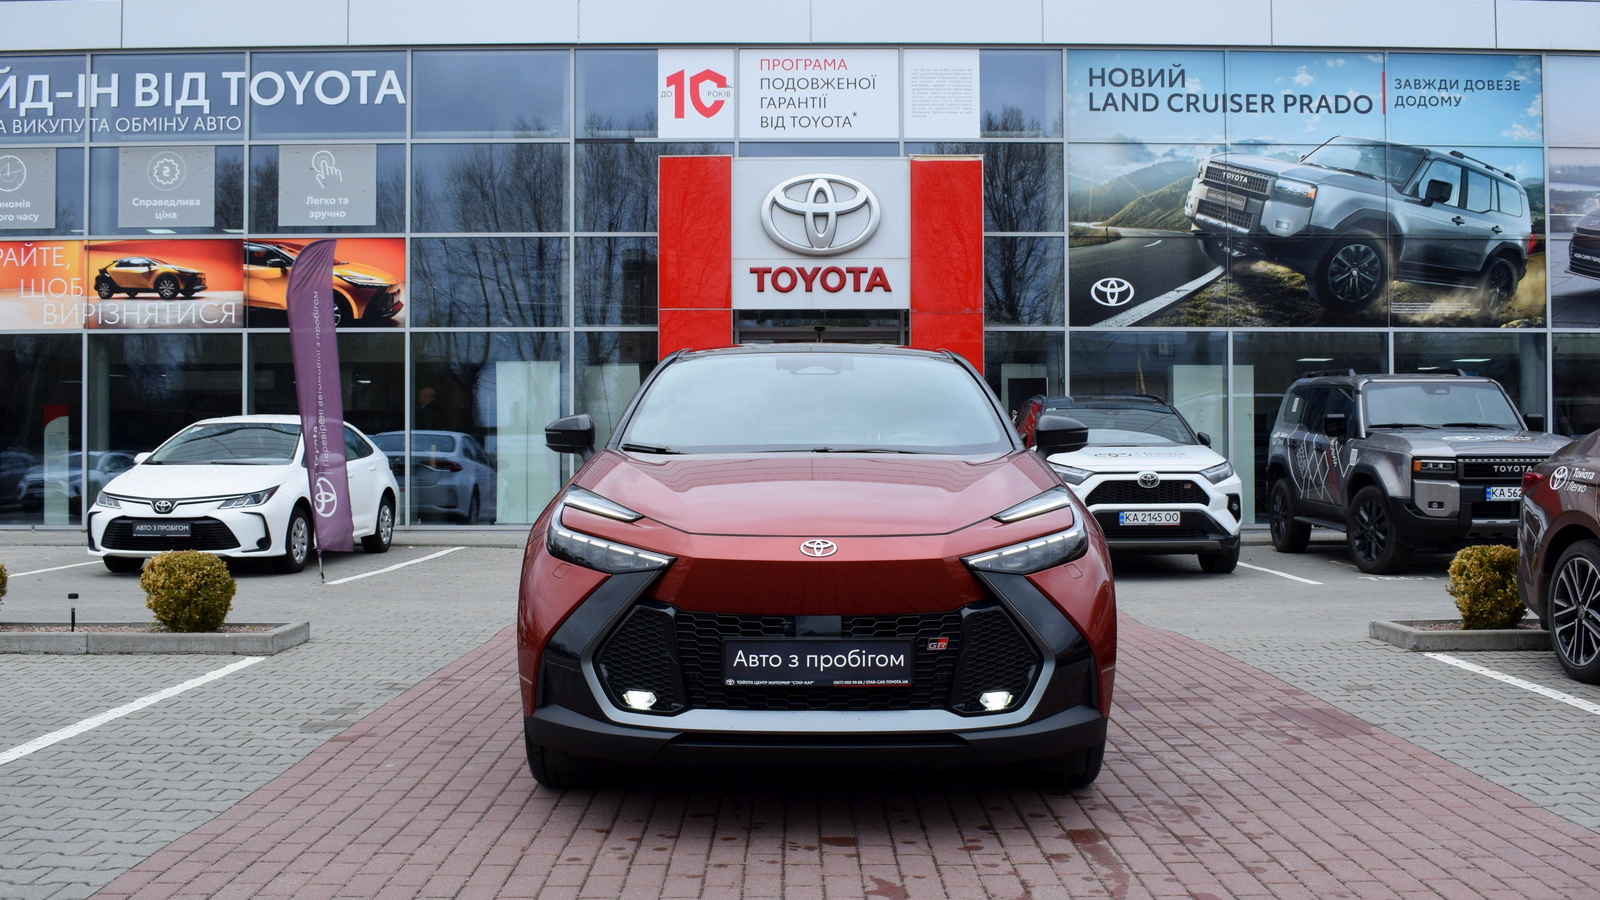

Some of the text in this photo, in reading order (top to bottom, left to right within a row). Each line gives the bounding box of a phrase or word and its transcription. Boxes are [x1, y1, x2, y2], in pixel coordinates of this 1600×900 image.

[759, 58, 848, 71] ПРОГРАМА
[1087, 64, 1186, 88] НОВИЙ
[759, 75, 877, 92] ПОДОВЖЕНОЇ
[1394, 78, 1521, 93] ЗАВЖДИ ДОВЕЗЕ
[135, 73, 209, 114] ВІД
[222, 70, 406, 106] TOYOTA
[660, 90, 673, 98] ДО
[707, 90, 731, 98] РОКІВ
[759, 95, 827, 109] ГАРАНТІЇ
[1088, 92, 1374, 115] LAND CRUISER PRADO
[1394, 95, 1463, 108] ДОДОМУ
[12, 118, 85, 134] ВИКУПУ
[90, 118, 110, 132] ТА
[115, 115, 190, 132] ОБМІНУ
[193, 116, 242, 131] АВТО
[759, 116, 786, 131] ВІД
[1222, 171, 1248, 184] TOYOTA
[132, 197, 201, 209] Справедлива
[306, 196, 349, 205] Легко та
[16, 214, 39, 223] часу
[155, 211, 177, 220] ціна
[309, 211, 346, 219] зручно
[750, 266, 892, 293] TOYOTA
[20, 277, 84, 301] ЩОБ
[43, 302, 236, 325] ВИРІЗНЯТИСЯ
[312, 291, 320, 339] пробігом
[318, 409, 330, 467] Перевірені
[1493, 465, 1533, 473] TOYOTA
[1573, 467, 1596, 481] Тойота
[1491, 488, 1506, 498] KA
[1567, 480, 1587, 493] Легко
[1125, 513, 1139, 522] KA
[1141, 513, 1162, 522] 2145
[733, 649, 904, 672] Авто з пробігом
